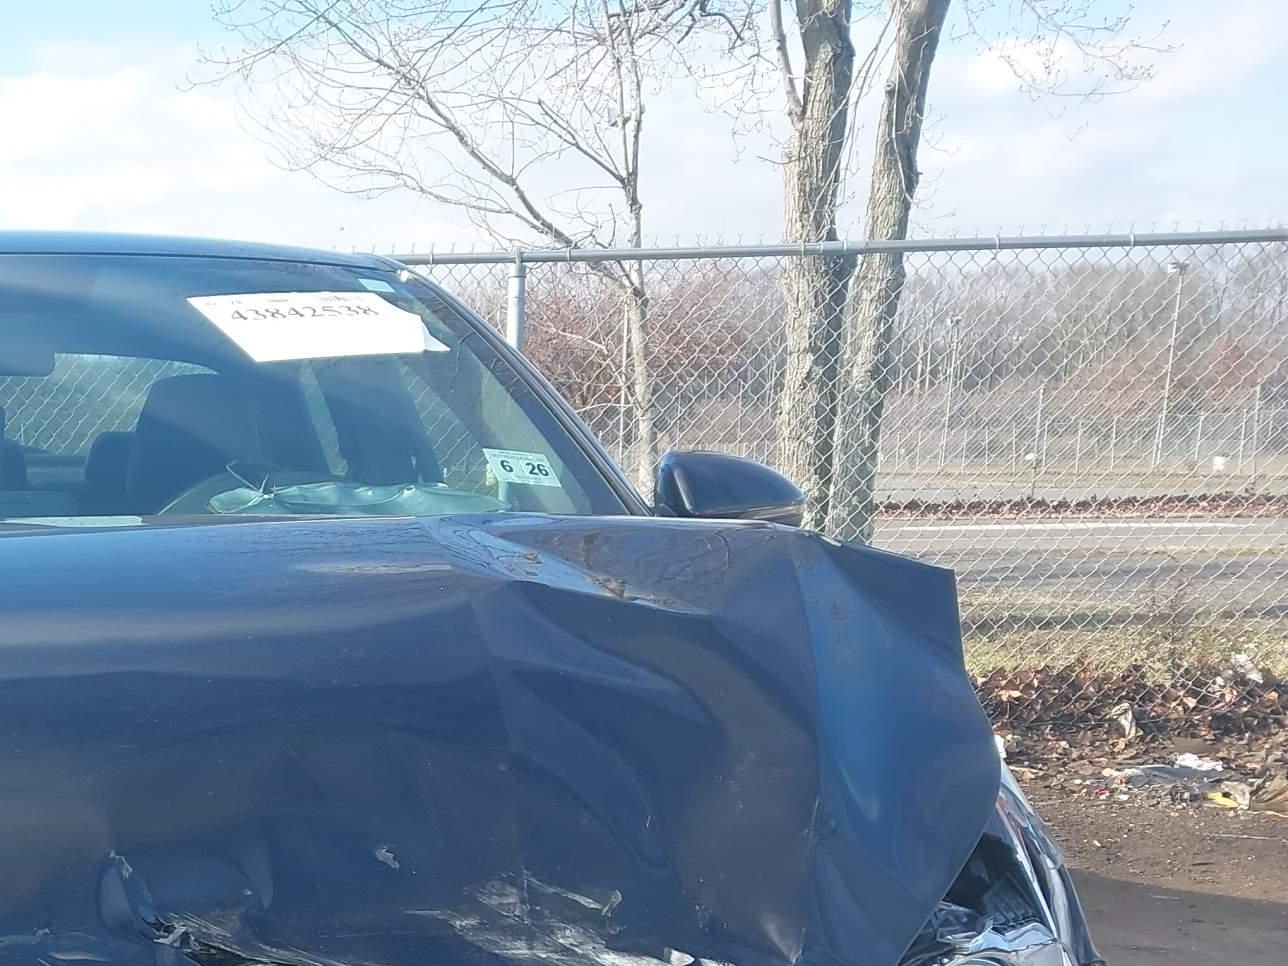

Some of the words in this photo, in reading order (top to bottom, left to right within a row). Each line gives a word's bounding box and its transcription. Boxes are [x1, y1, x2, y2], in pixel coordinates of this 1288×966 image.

[231, 305, 380, 321] 43842538
[500, 459, 514, 473] 6
[525, 462, 550, 477] 26
